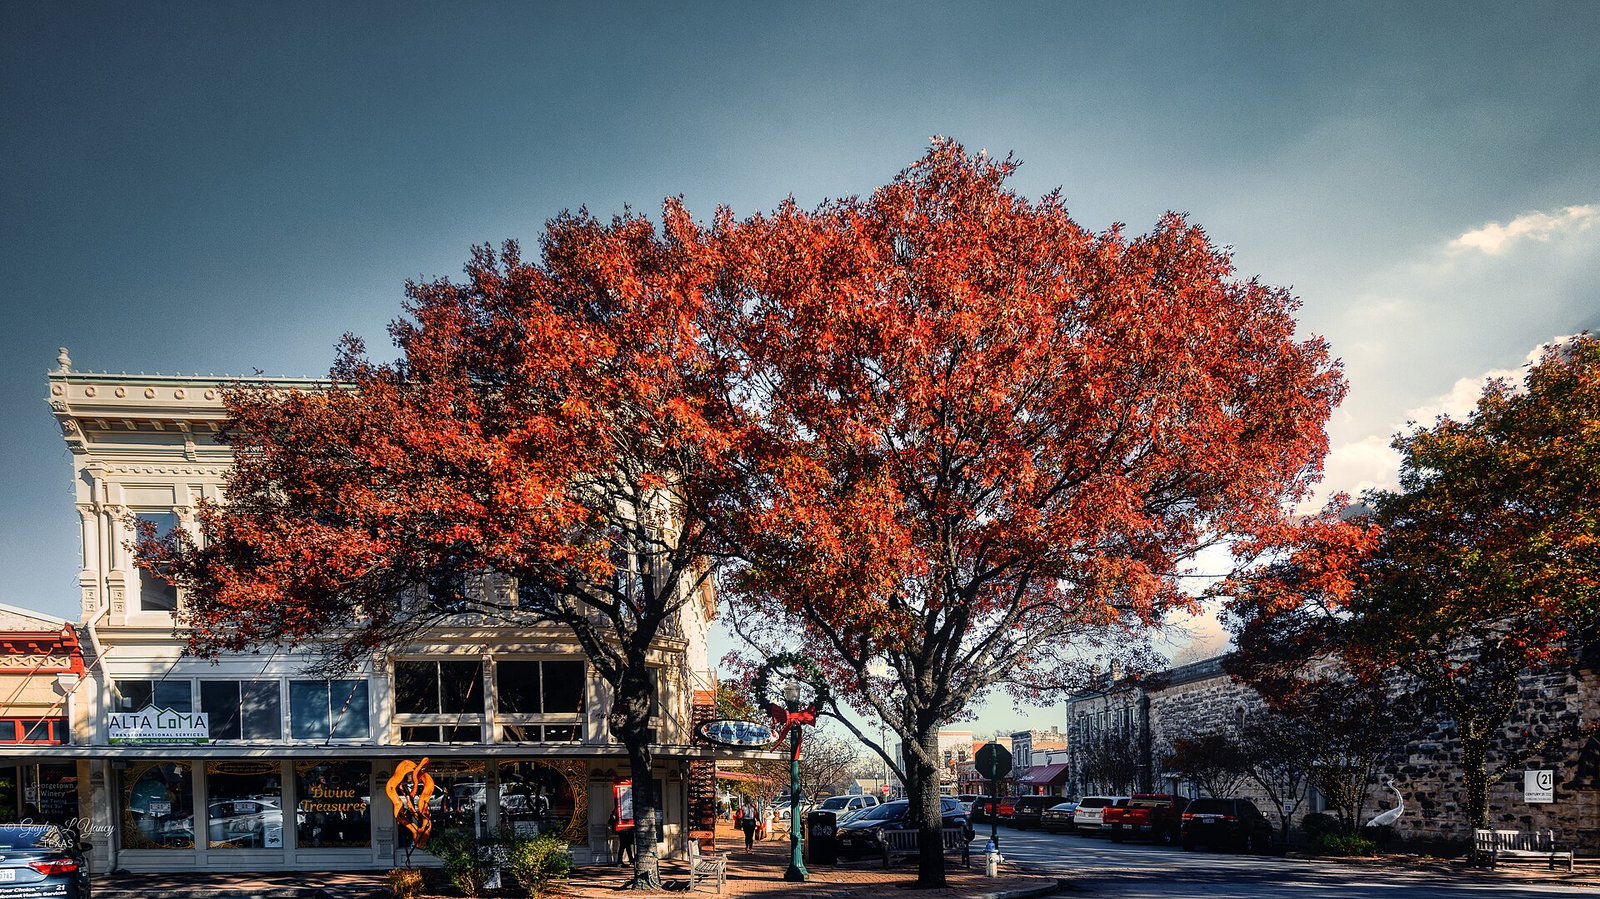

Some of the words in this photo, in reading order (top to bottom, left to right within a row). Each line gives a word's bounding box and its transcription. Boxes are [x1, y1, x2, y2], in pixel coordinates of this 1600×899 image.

[109, 715, 152, 729] ALTA
[31, 782, 74, 790] Gorgetown
[309, 784, 355, 798] Divine
[41, 790, 65, 798] Winery
[301, 799, 367, 812] Treasures
